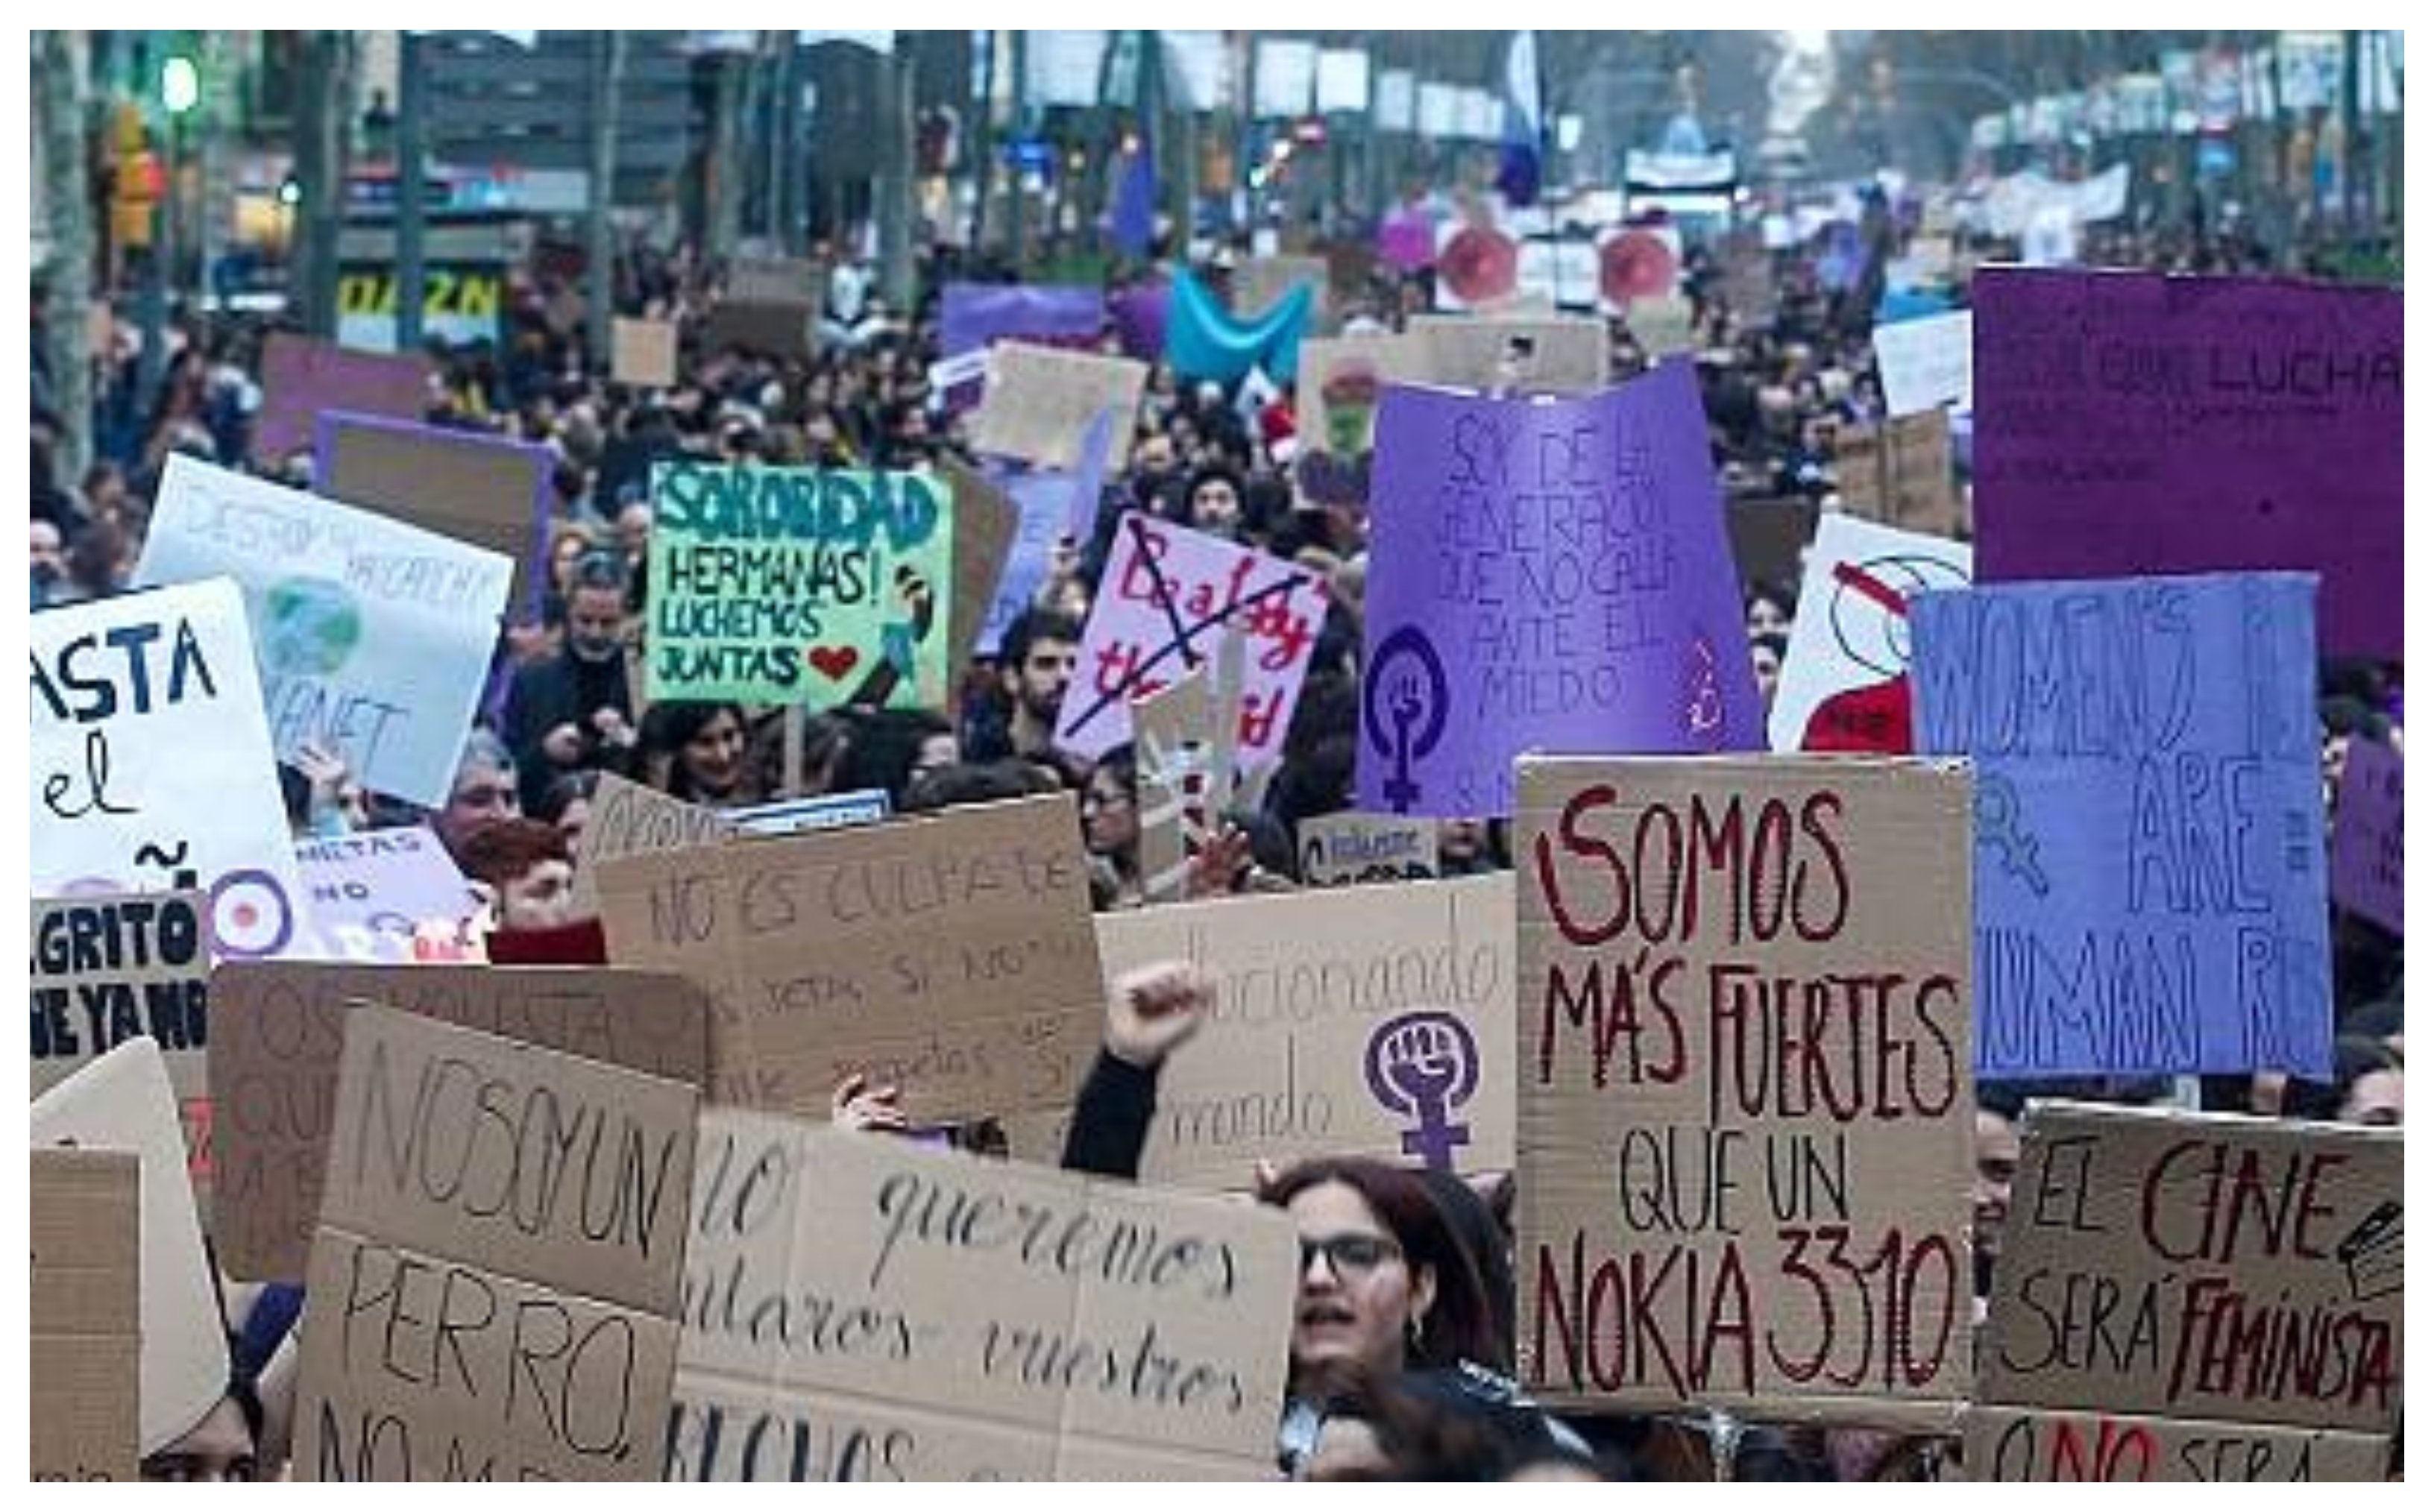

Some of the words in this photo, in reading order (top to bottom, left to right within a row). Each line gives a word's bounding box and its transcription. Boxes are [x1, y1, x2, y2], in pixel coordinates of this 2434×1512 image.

[1538, 425, 1599, 488] DE
[659, 599, 823, 640] LUCHEMOS
[667, 546, 881, 608] HERMANAS!
[656, 644, 801, 684] JUNTAS
[1475, 666, 1624, 720] MIEDO
[43, 728, 140, 820] el
[1533, 783, 1849, 947] SOMOS
[2125, 753, 2271, 914] ARE
[40, 898, 198, 975] GRITO
[647, 865, 714, 950] NO
[741, 865, 796, 936] ES
[1539, 945, 1688, 1090] MÁS
[1708, 962, 1961, 1126] FUERTES
[1167, 1032, 1333, 1147] mundo
[869, 1166, 1235, 1299] queremos
[1618, 1127, 1748, 1236] QUE
[1764, 1132, 1851, 1223] UN
[2033, 1133, 2106, 1233] EL
[2140, 1138, 2352, 1263] CINE
[1532, 1229, 1755, 1400] NOKIA
[1767, 1224, 1960, 1390] 3310
[2000, 1266, 2174, 1373] SERÁ
[984, 1320, 1244, 1417] vuestros
